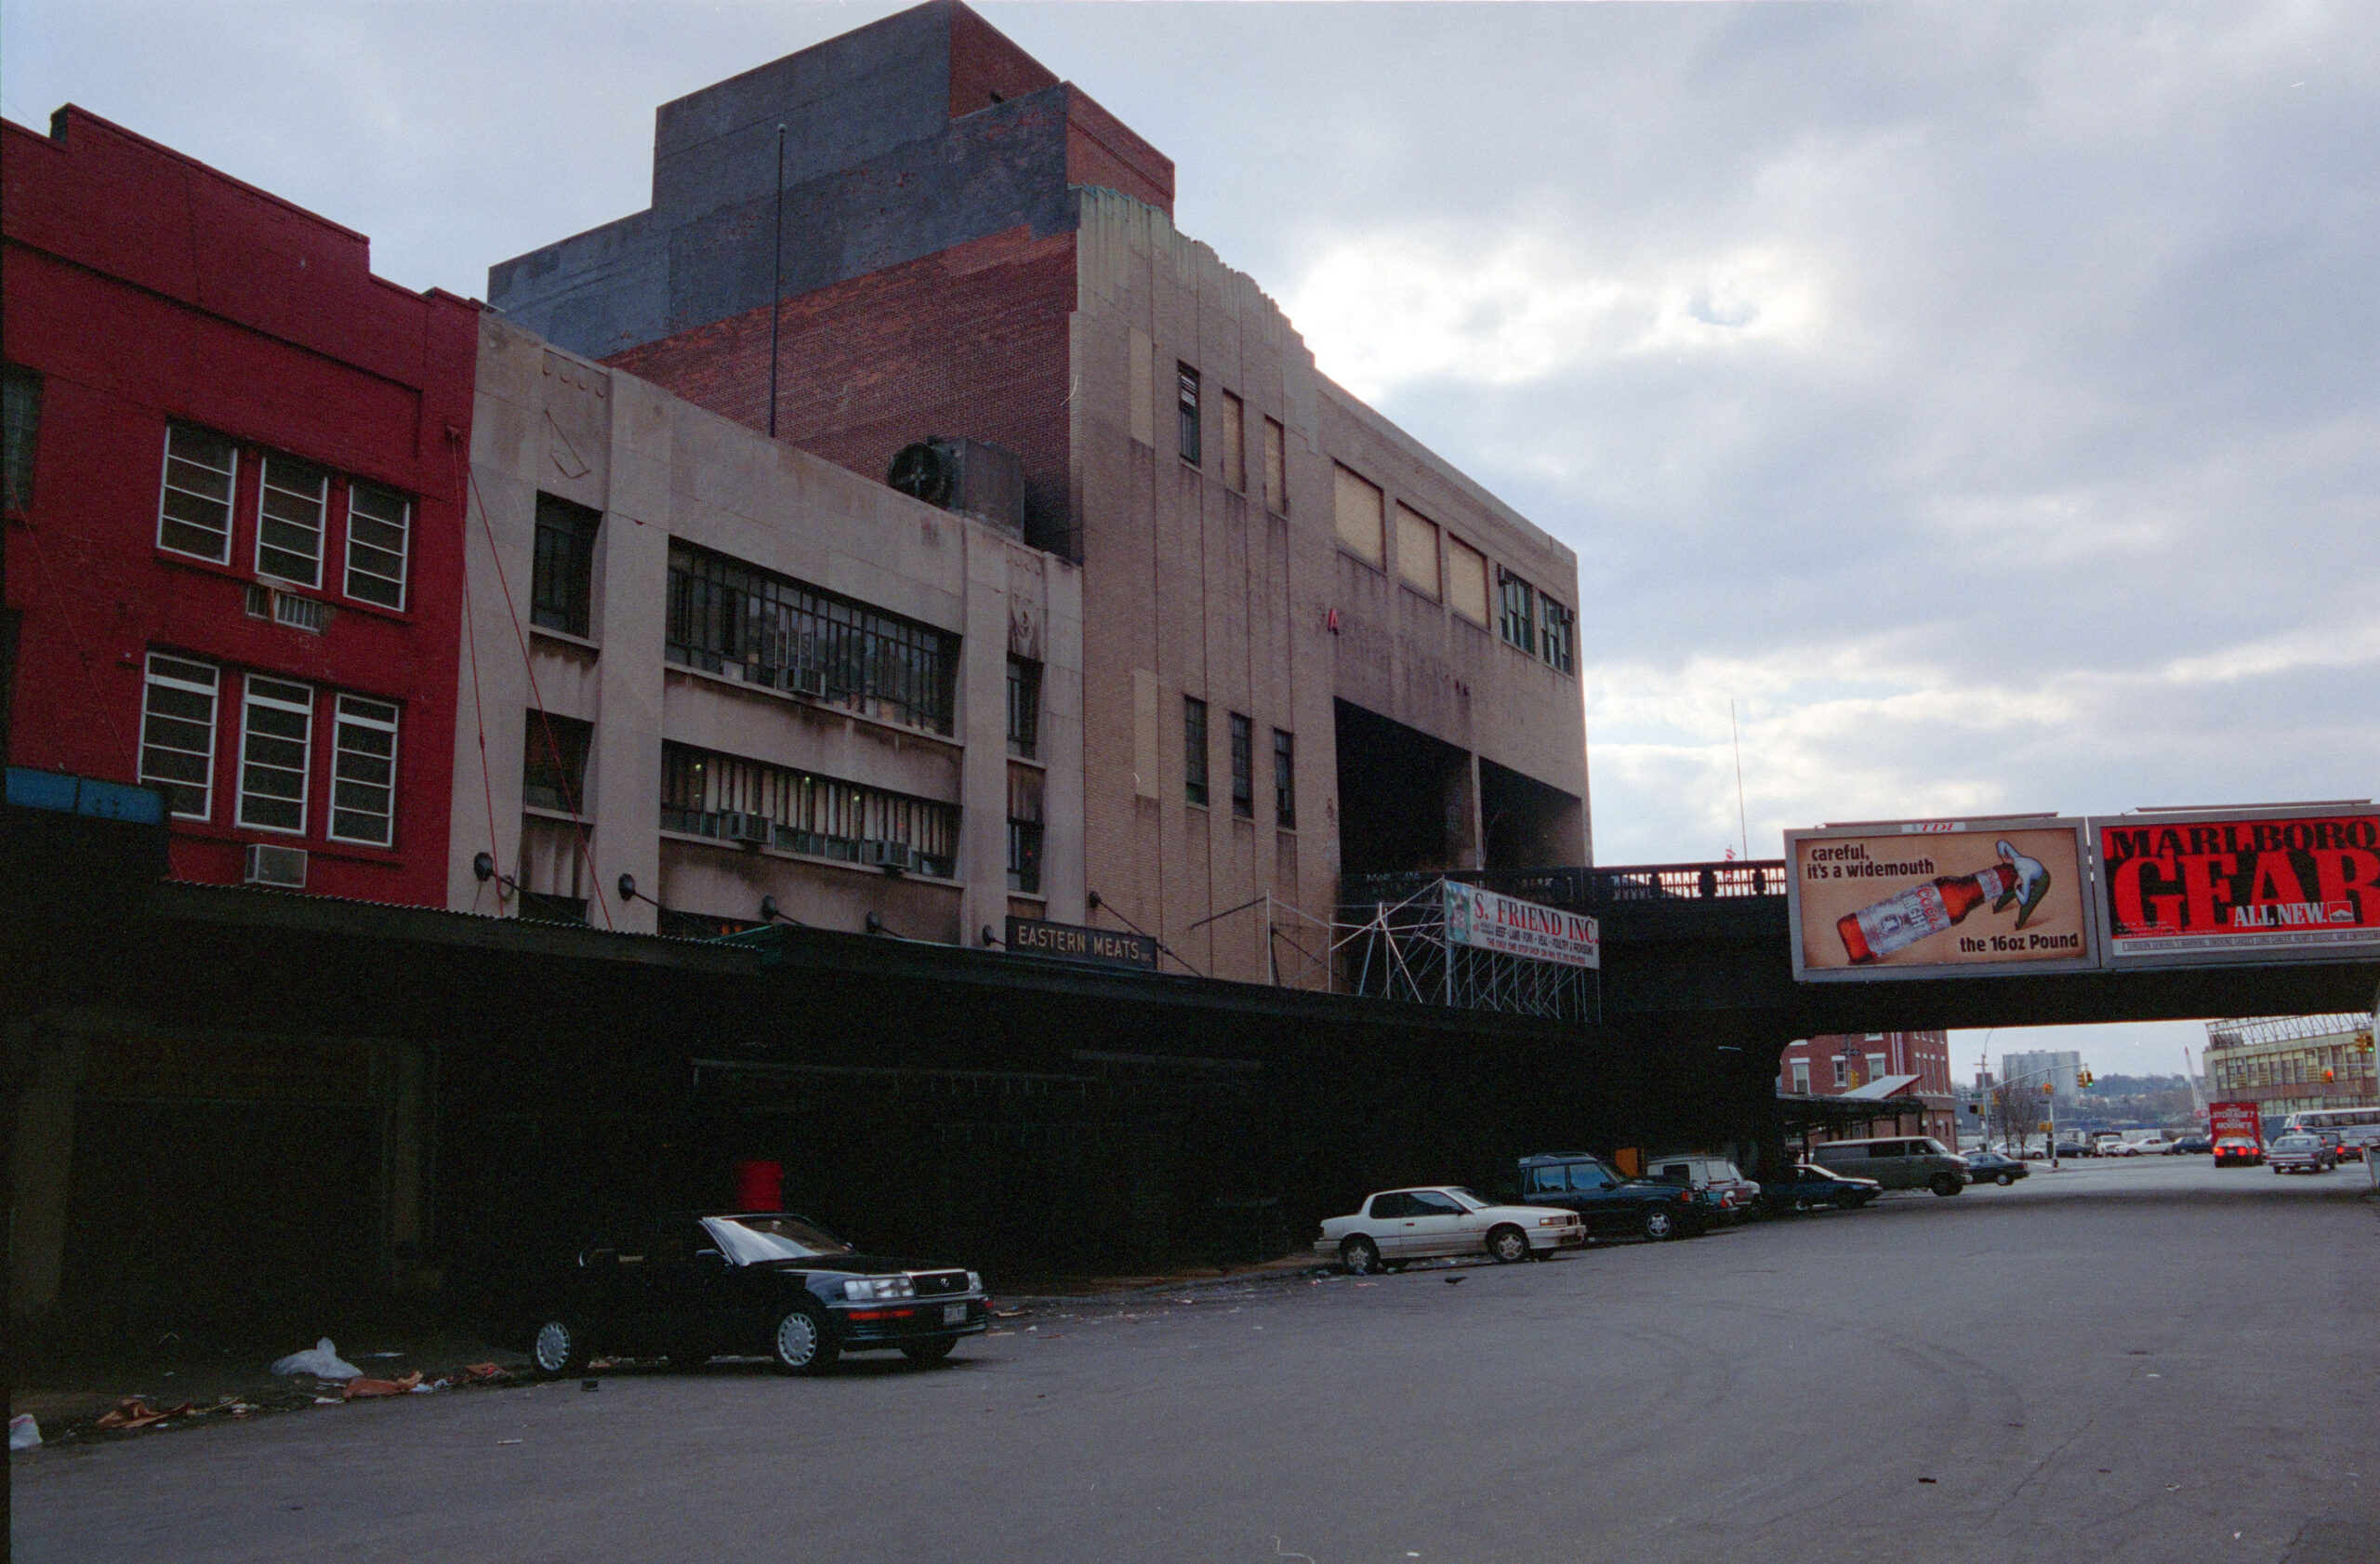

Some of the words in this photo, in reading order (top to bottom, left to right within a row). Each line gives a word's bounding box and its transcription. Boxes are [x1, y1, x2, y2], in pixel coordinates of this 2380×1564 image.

[1921, 823, 1953, 831] TDI
[2110, 820, 2377, 857] MARLBORO
[1811, 843, 1870, 861] careful,
[1806, 863, 1829, 880] it's
[1832, 865, 1843, 879] a
[1845, 858, 1935, 878] widemouth
[2113, 849, 2380, 933] GEAR
[1474, 893, 1489, 920] S.
[1497, 898, 1562, 936] FRIEND
[1568, 916, 1599, 944] INC.
[2233, 906, 2276, 927] ALL
[2276, 902, 2328, 925] NEW.
[1017, 925, 1087, 953] EASTERN
[1092, 935, 1140, 960] MEATS
[1960, 936, 1987, 952] the
[1990, 935, 2025, 951] 16oz
[2030, 933, 2079, 948] Pound
